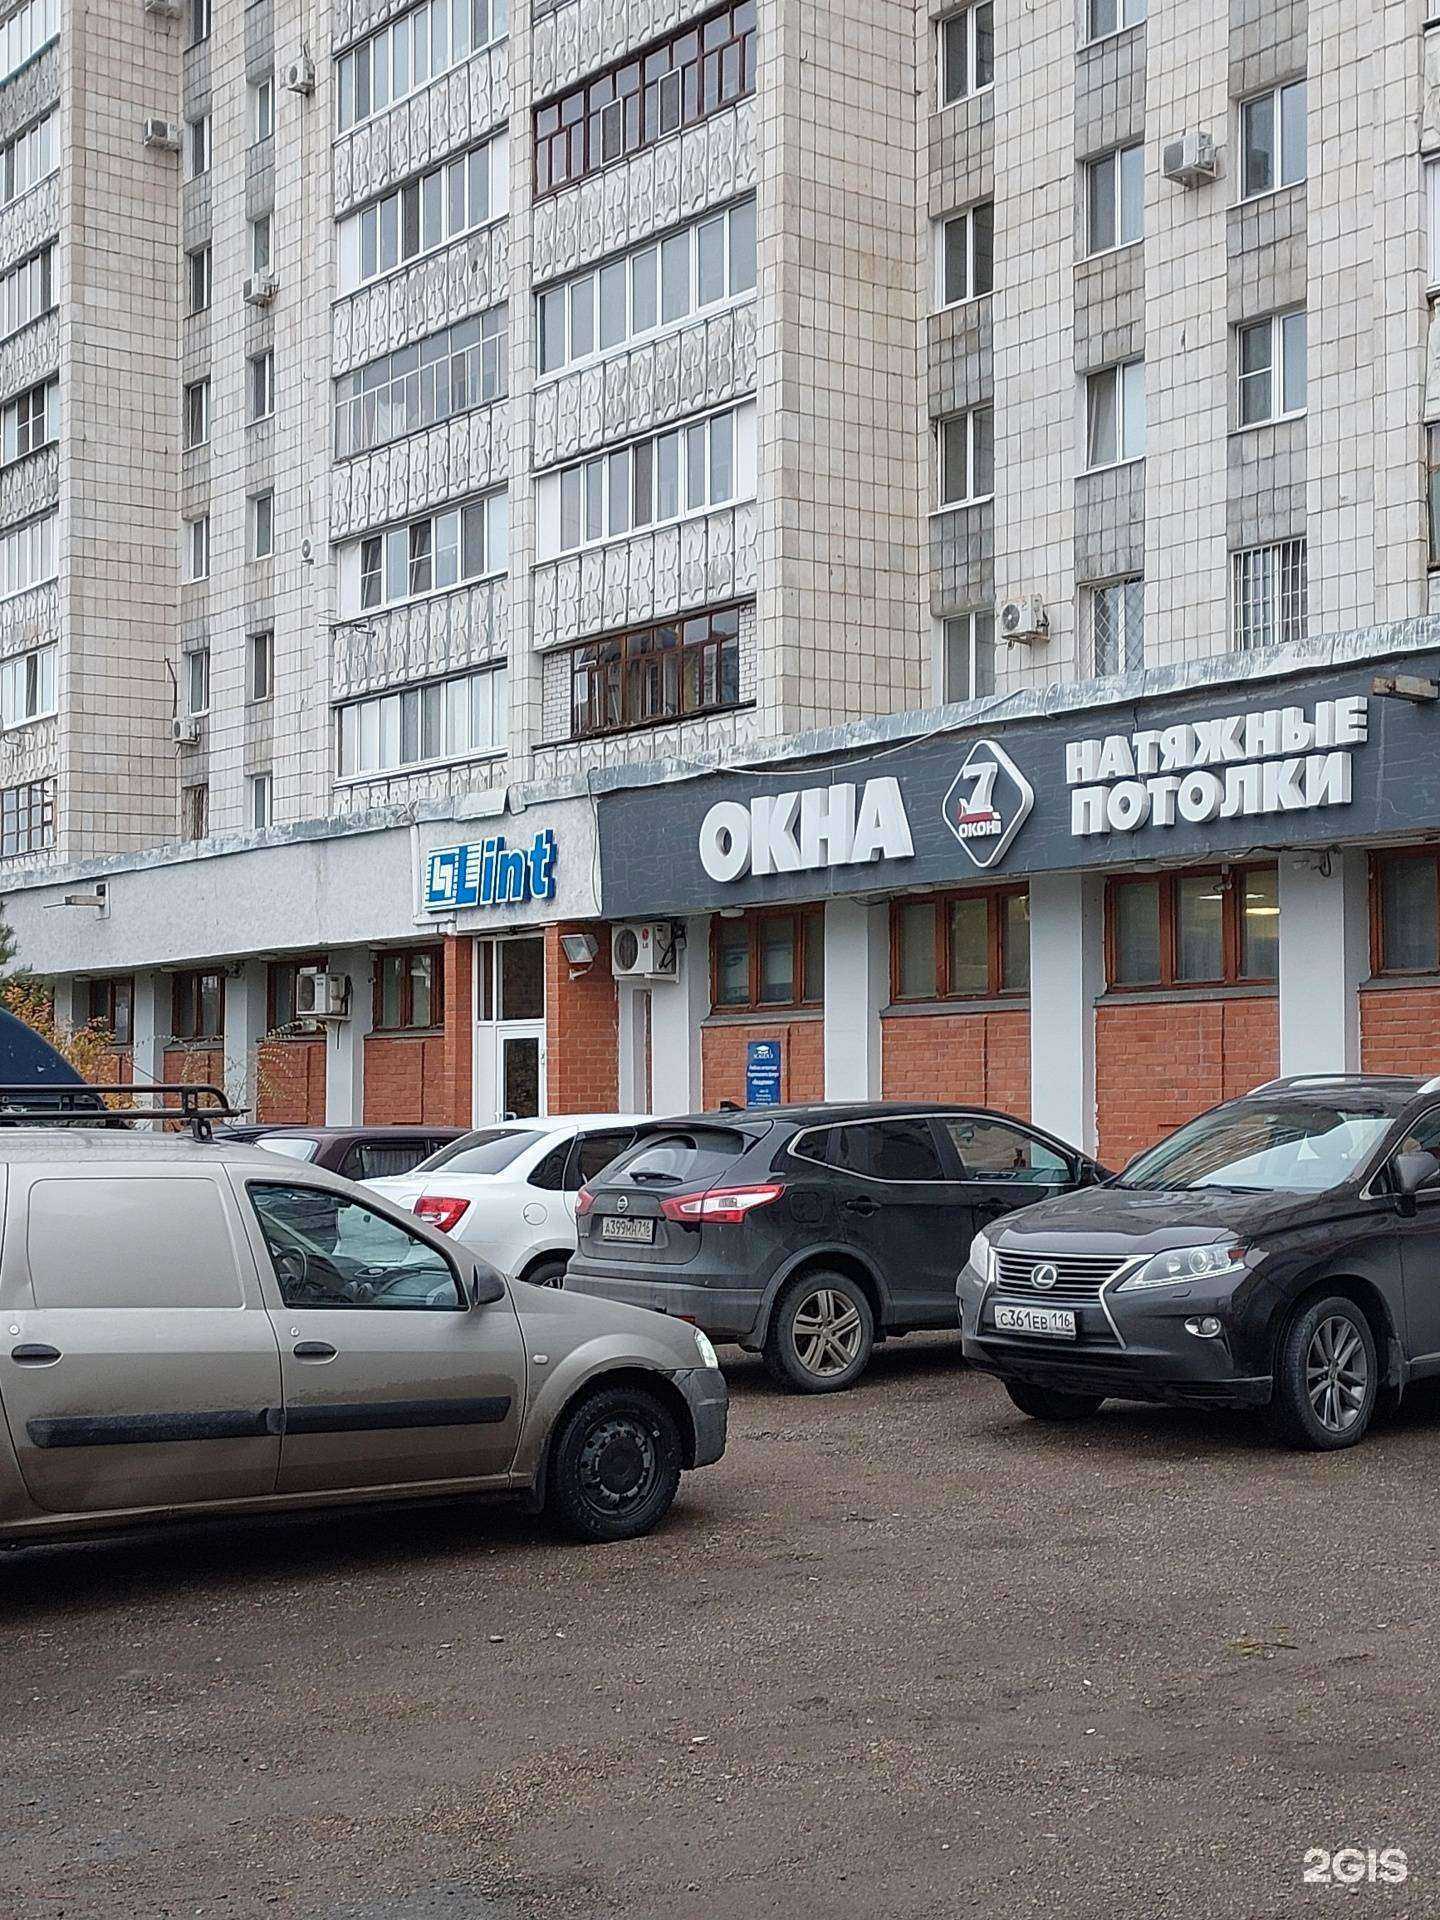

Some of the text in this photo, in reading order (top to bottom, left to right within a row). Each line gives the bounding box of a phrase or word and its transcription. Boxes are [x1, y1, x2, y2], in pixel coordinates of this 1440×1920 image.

[1065, 695, 1368, 785] НАТЯЖНЫЕ
[699, 776, 915, 883] ОКНА
[958, 820, 1002, 838] ОКОН
[962, 761, 998, 813] 7
[1071, 751, 1352, 836] ПОТОЛКИ
